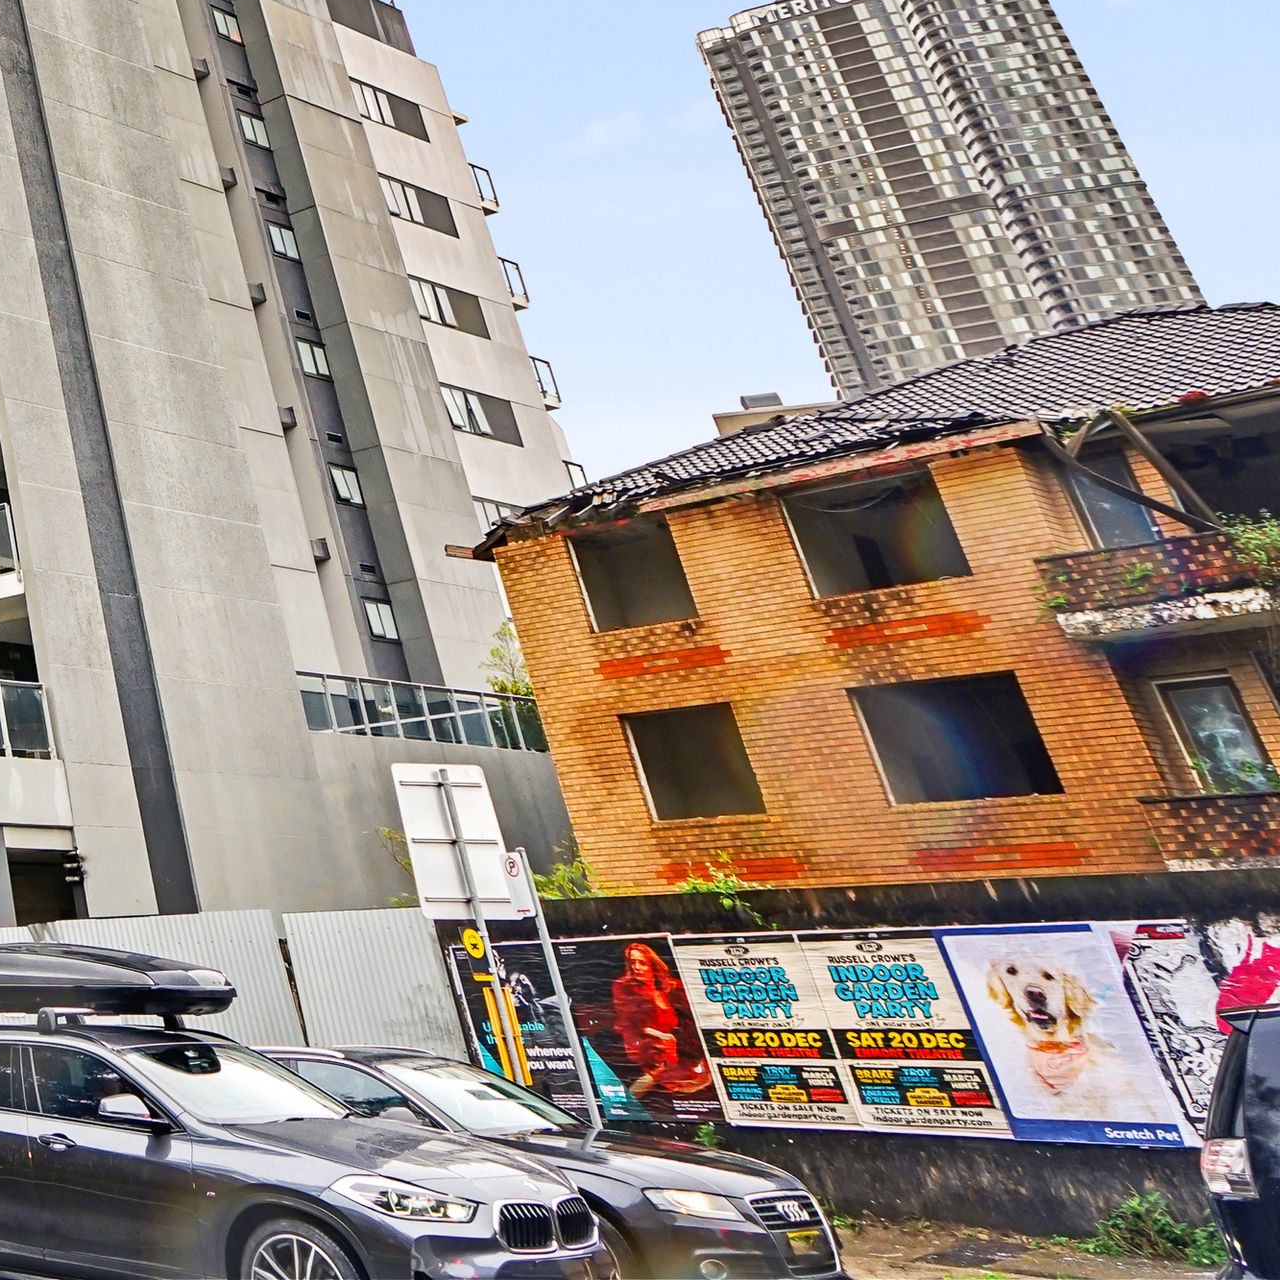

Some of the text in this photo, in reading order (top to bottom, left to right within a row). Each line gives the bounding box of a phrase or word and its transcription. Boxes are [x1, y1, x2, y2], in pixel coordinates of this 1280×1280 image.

[698, 957, 779, 967] RUSSELL CROWE'S
[827, 953, 916, 964] RUSSELL CROWE'S
[698, 966, 790, 985] INDOOR
[827, 963, 928, 983] INDOOR
[705, 984, 799, 1002] GARDEN
[835, 982, 939, 1001] GARDEN
[721, 1001, 793, 1019] PARTY
[854, 1000, 933, 1019] PARTY
[714, 1031, 823, 1048] SAT 20 DEC
[846, 1031, 966, 1049] SAT 20 DEC
[768, 1047, 821, 1059] THEATRE
[854, 1048, 964, 1060] ENMORE THEATRE
[546, 1059, 575, 1070] want
[764, 1066, 791, 1075] TROY
[722, 1067, 758, 1077] BRAKE
[855, 1069, 895, 1080] BRAKE
[901, 1068, 931, 1077] TROY
[943, 1073, 981, 1082] MARCIA
[740, 1103, 775, 1111] TICKETS
[793, 1104, 813, 1112] SALE
[817, 1105, 837, 1113] NOW
[874, 1106, 983, 1118] TICKETS ON SALE NOW
[738, 1110, 845, 1121] indoorgardenparty.com
[872, 1114, 992, 1127] indoorgardenparty.com
[1104, 1127, 1180, 1142] Scratch Pet
